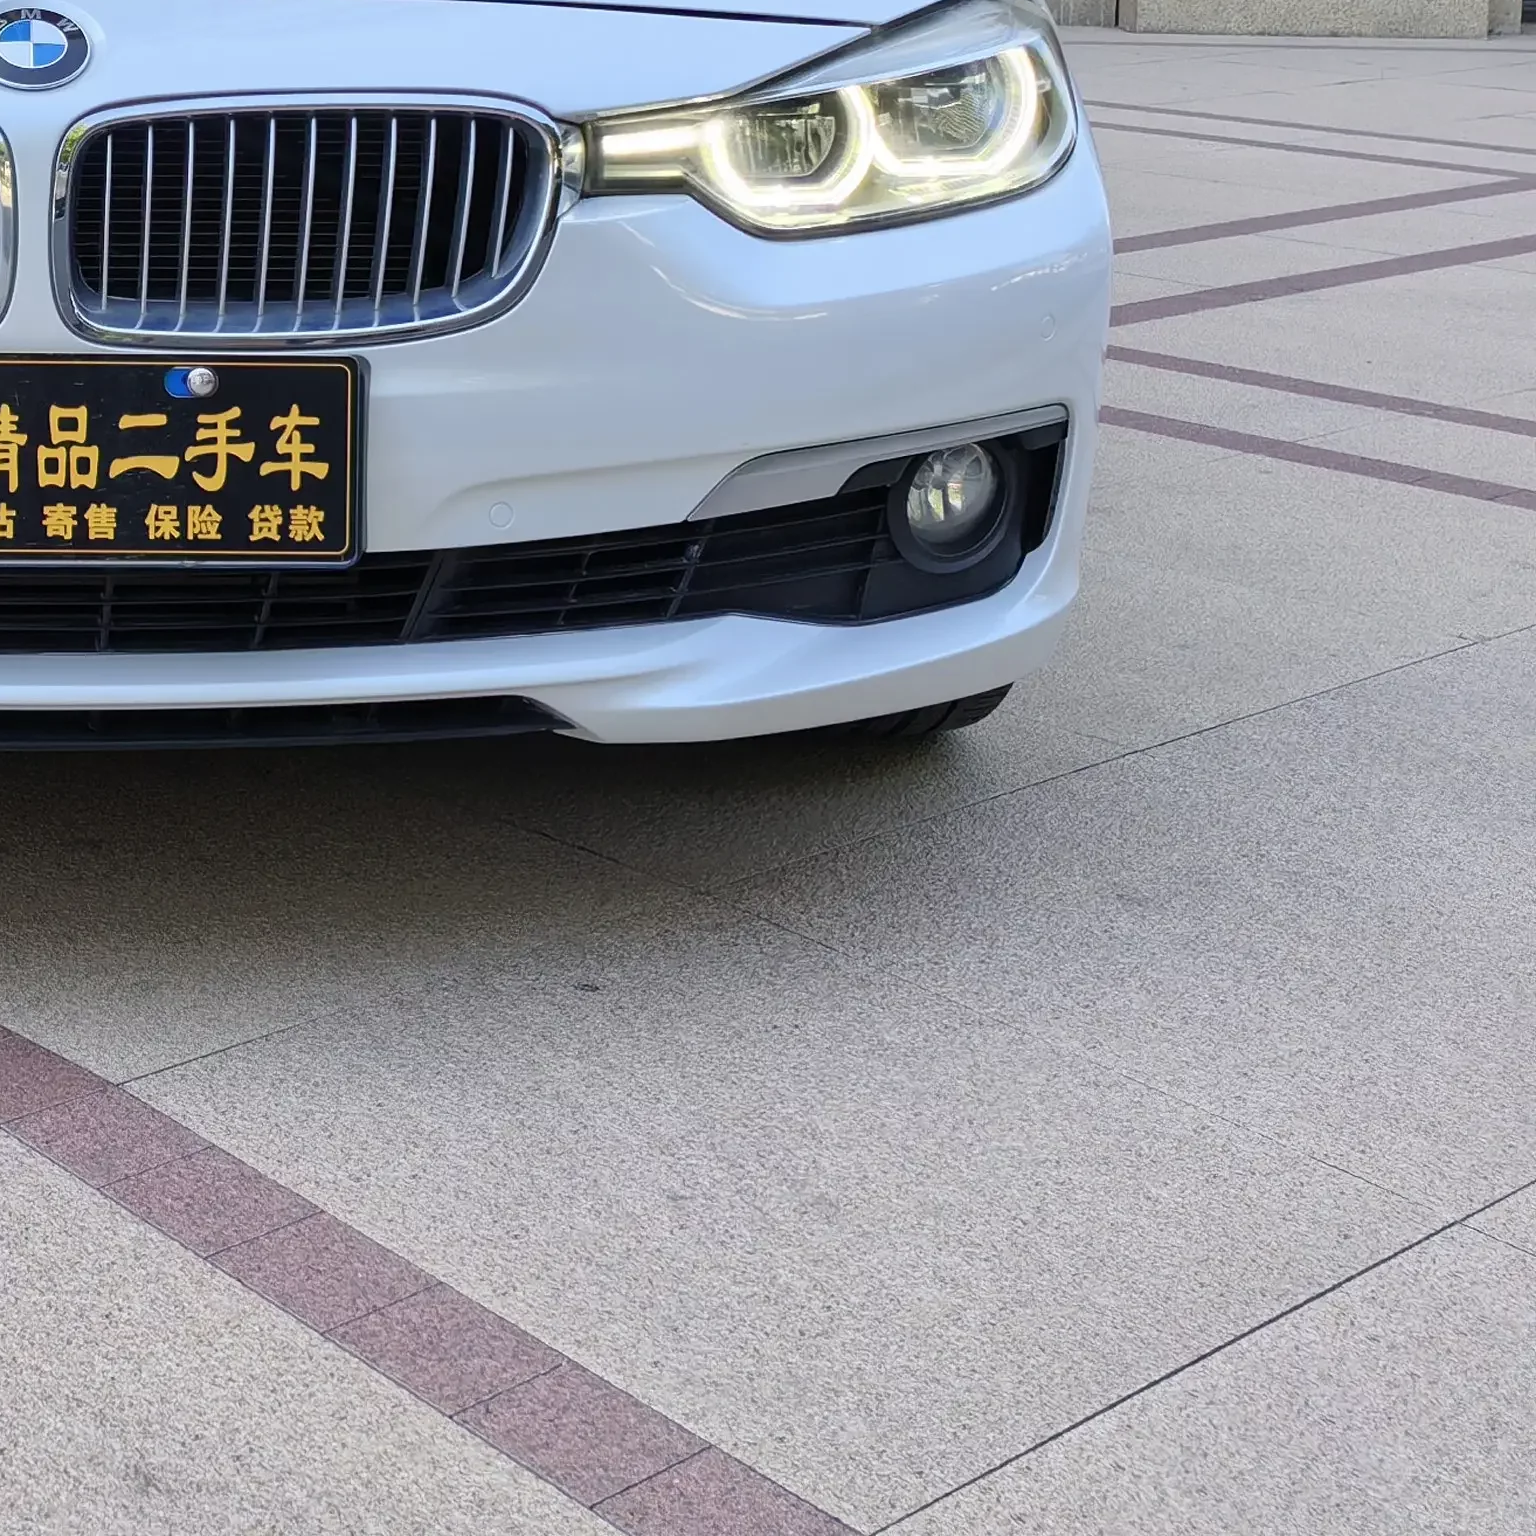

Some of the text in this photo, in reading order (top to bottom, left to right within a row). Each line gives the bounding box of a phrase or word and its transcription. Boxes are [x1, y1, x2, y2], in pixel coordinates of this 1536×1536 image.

[40, 503, 117, 540] 寄售
[143, 504, 222, 540] 保险
[247, 505, 325, 542] 贷款
